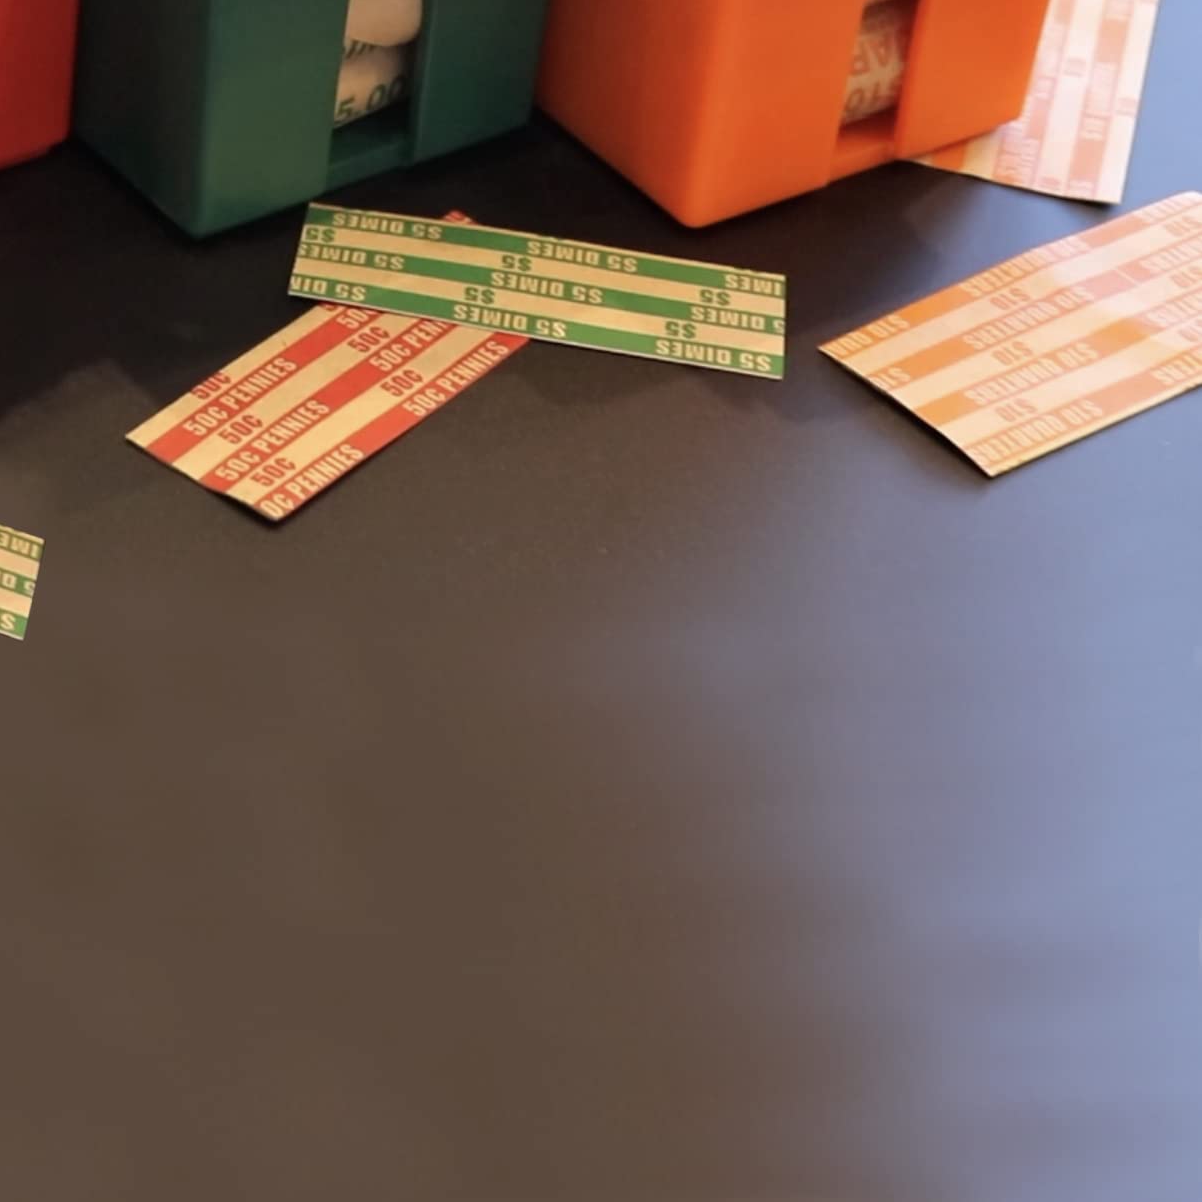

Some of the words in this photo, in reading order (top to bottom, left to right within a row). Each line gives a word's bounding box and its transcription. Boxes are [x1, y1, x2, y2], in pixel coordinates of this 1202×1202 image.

[332, 212, 405, 234] DIMES
[527, 240, 600, 264] DIMES
[490, 271, 564, 298] DIMES
[724, 274, 782, 295] IMES
[453, 304, 529, 331] DIMES
[690, 305, 766, 331] DIMES
[655, 339, 732, 366] DIMES
[434, 340, 510, 396] PENNIES
[218, 357, 298, 410] PENNIES
[250, 399, 330, 454] PENNIES
[285, 443, 365, 500] PENNIES
